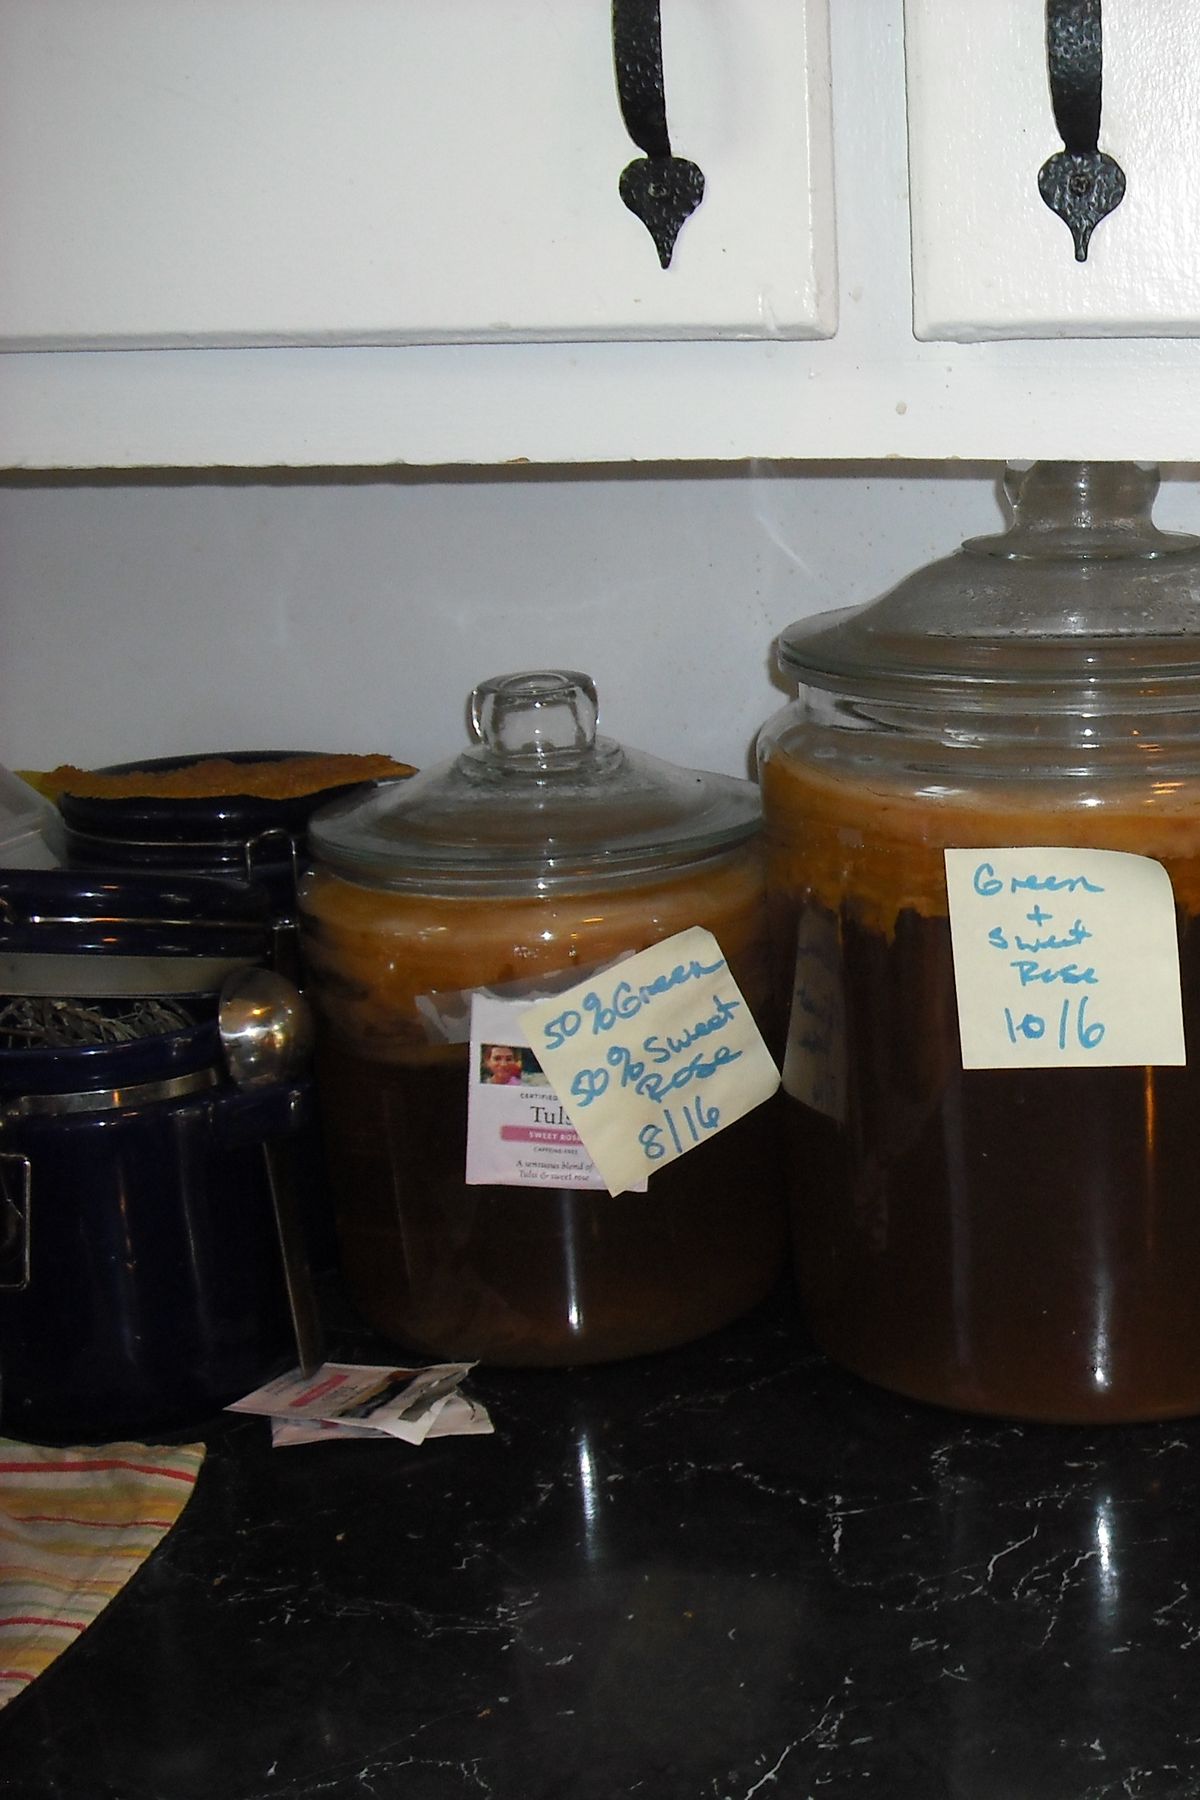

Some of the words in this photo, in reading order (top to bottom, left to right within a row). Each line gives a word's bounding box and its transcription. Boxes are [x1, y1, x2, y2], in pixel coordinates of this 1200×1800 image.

[973, 862, 1105, 897] Green
[988, 919, 1093, 953] Sweet
[612, 959, 726, 1019] Green
[1010, 960, 1099, 986] Rose
[643, 995, 741, 1064] Sweet
[1004, 995, 1106, 1050] 10/6
[520, 1092, 559, 1101] CERTIFIED
[634, 1046, 743, 1104] Rose
[529, 1130, 558, 1140] SWEET
[638, 1095, 721, 1160] 8/16
